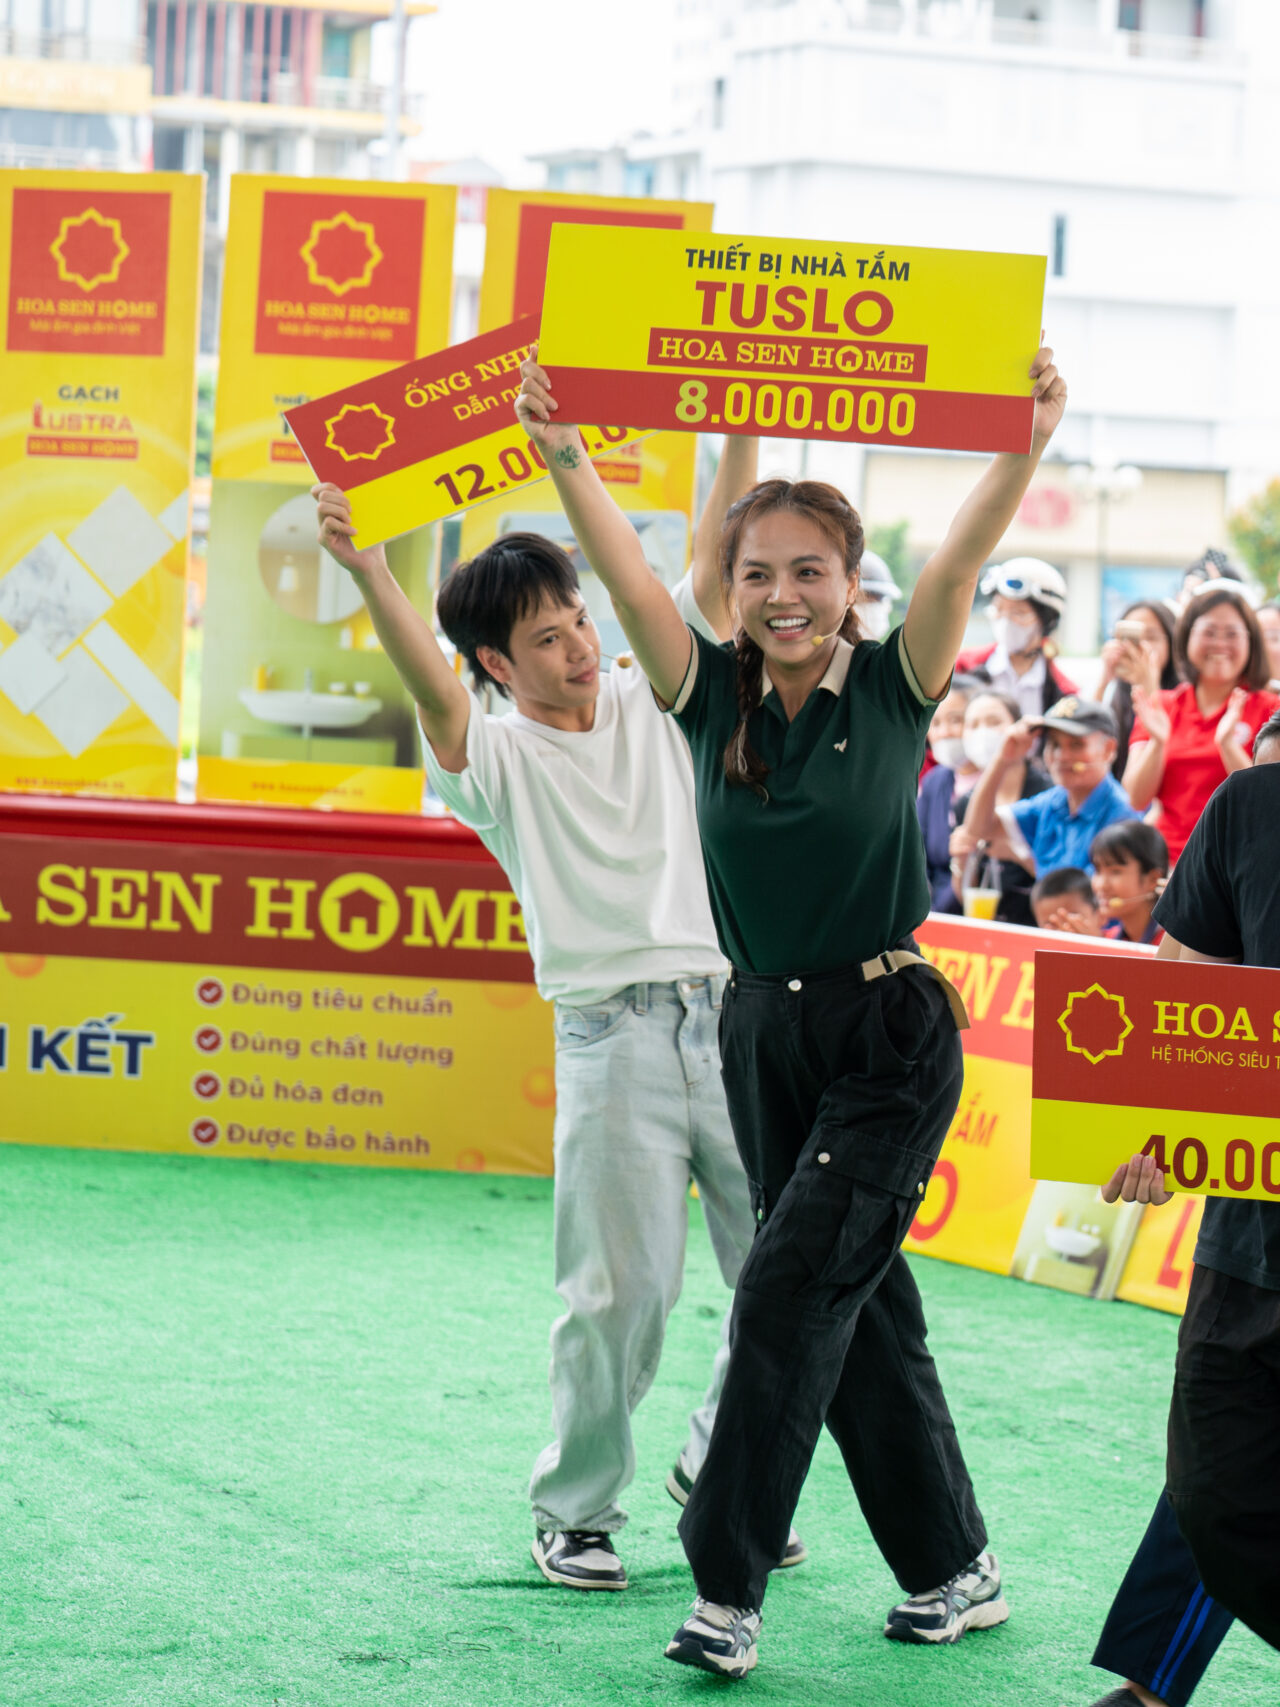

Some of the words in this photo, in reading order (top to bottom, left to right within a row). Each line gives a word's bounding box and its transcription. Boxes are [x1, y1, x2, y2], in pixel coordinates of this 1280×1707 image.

[685, 243, 751, 271] THIẾT
[758, 254, 782, 279] BỊ
[791, 251, 847, 278] NHÀ
[856, 250, 911, 281] TẮM
[17, 298, 55, 315] HOA
[58, 299, 95, 316] SEN
[98, 299, 158, 319] HOME
[264, 301, 305, 319] HOA
[307, 303, 346, 320] SEN
[348, 304, 411, 324] HOME
[695, 280, 894, 336] TUSLO
[658, 336, 728, 363] HOA
[736, 341, 801, 367] SEN
[810, 344, 915, 375] HOME
[58, 384, 120, 405] GẠCH
[404, 377, 473, 409] ỐNG
[452, 393, 499, 421] Dẫn
[675, 380, 916, 436] 8.000.000
[37, 864, 222, 934] SEN
[245, 872, 531, 951] HOME
[232, 983, 302, 1011] Đúng
[312, 987, 363, 1010] tiêu
[1153, 1001, 1259, 1042] HOA
[30, 1013, 154, 1076] KẾT
[231, 1031, 300, 1059] Đúng
[311, 1034, 367, 1059] chất
[377, 1039, 453, 1067] lượng
[1151, 1044, 1172, 1063] HỆ
[1176, 1045, 1234, 1067] THỐNG
[1238, 1049, 1270, 1069] SIÊU
[228, 1075, 264, 1099] Đủ
[274, 1080, 323, 1102] hóa
[332, 1083, 384, 1107] đơn
[227, 1122, 296, 1151] Được
[306, 1125, 356, 1151] bảo
[365, 1130, 431, 1156] hành
